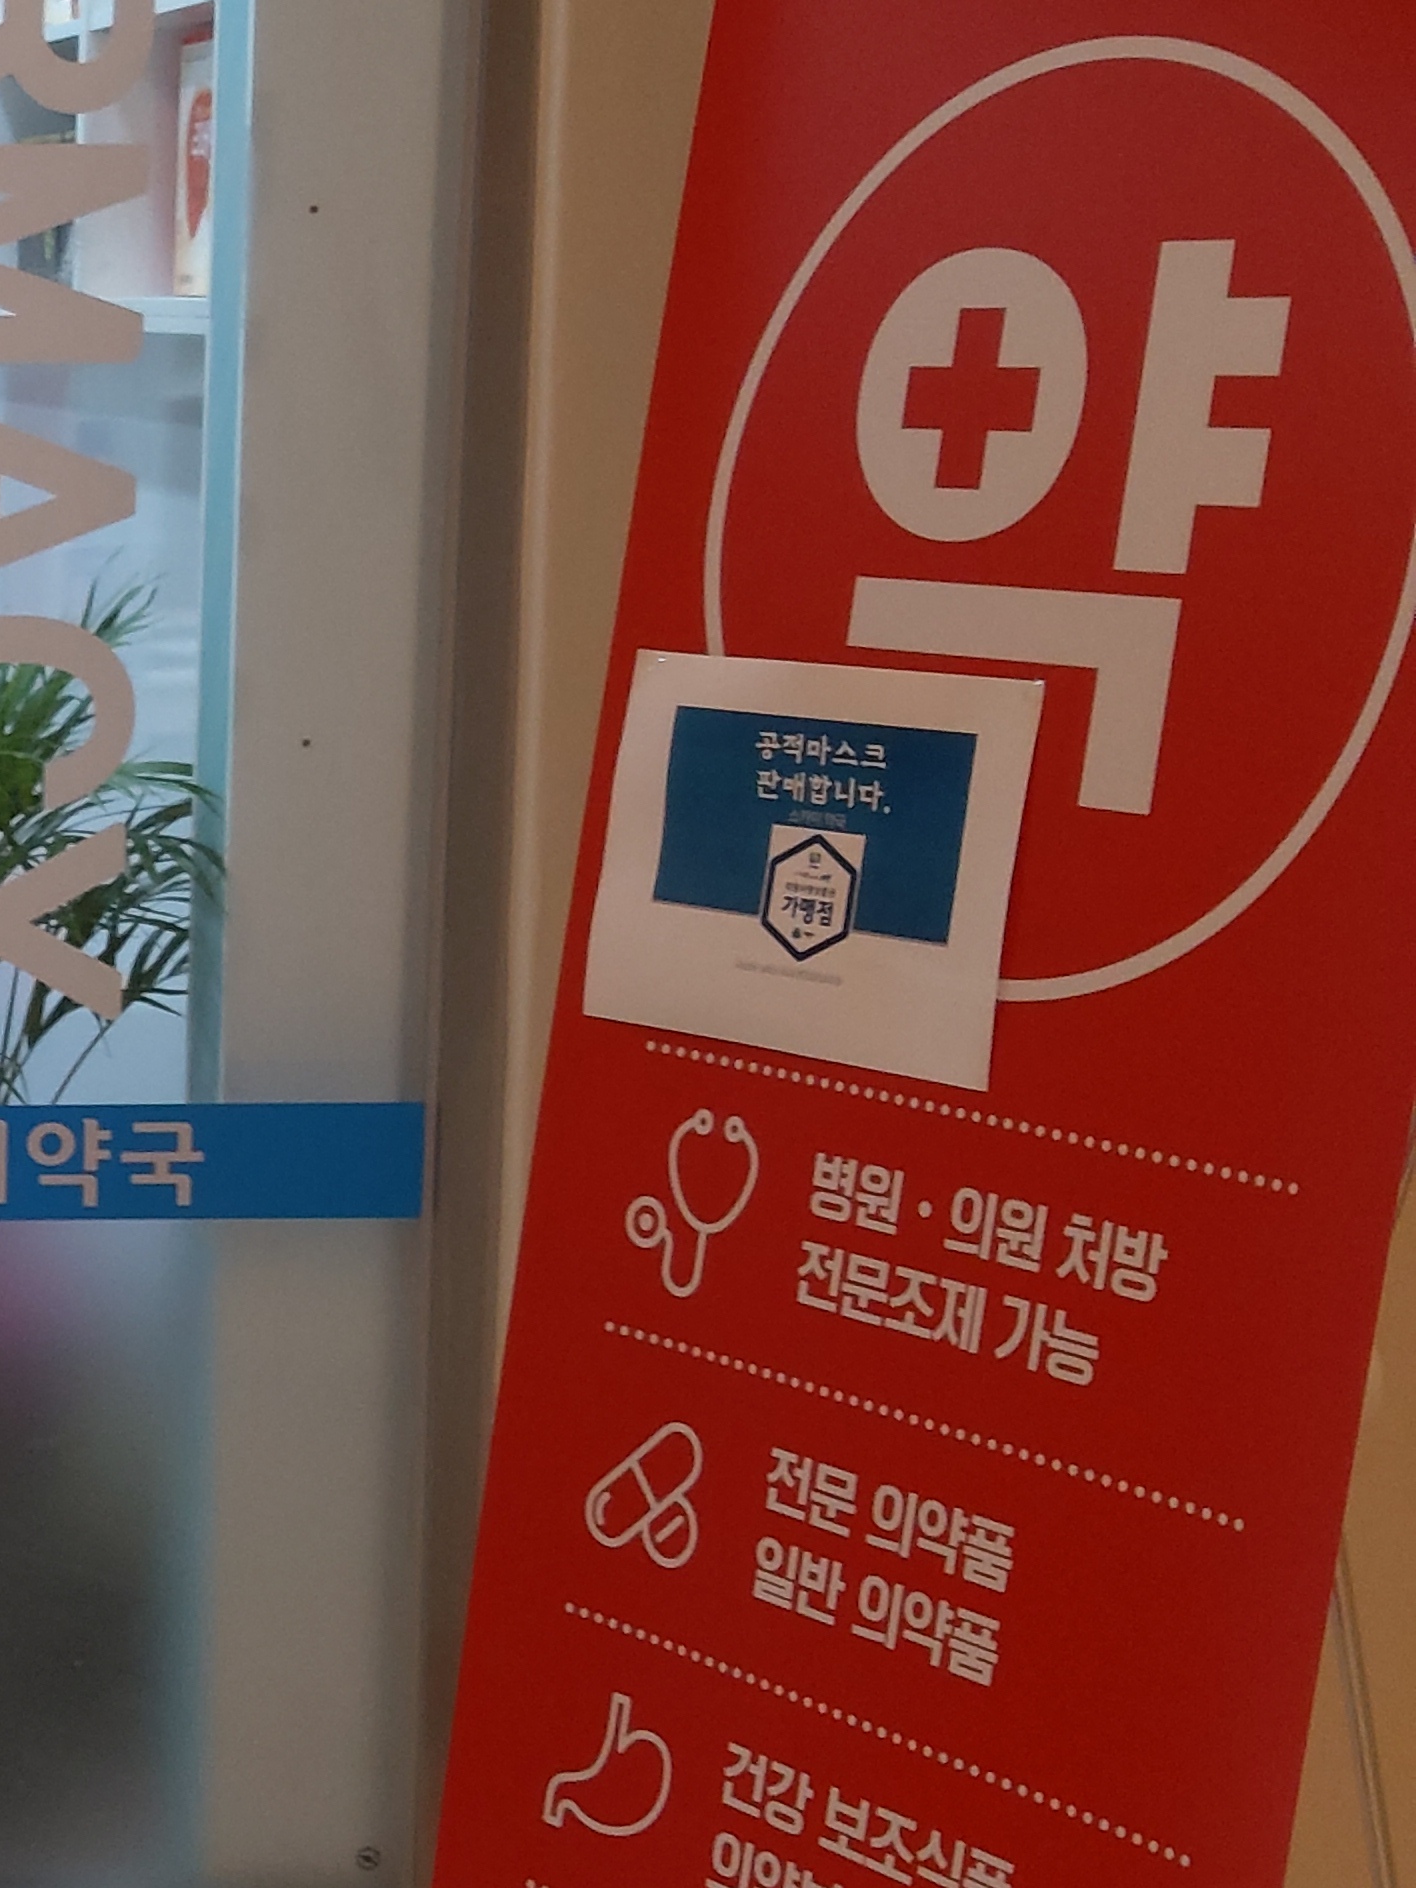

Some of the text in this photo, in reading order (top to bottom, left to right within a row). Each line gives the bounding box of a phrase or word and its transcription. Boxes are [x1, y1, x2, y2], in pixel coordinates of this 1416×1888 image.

[846, 238, 1293, 816] 약
[755, 730, 887, 769] 공적마스크
[755, 769, 892, 814] 판매합니다.
[781, 895, 835, 927] 가맹점
[809, 1151, 906, 1236] 병원
[942, 1185, 1049, 1273] 의원
[1054, 1212, 1170, 1303] 처방
[796, 1240, 1101, 1387] 전문조제 가능
[765, 1445, 1016, 1594] 전문 의약품
[752, 1535, 1002, 1687] 일반 의약품
[722, 1741, 815, 1837] 건강
